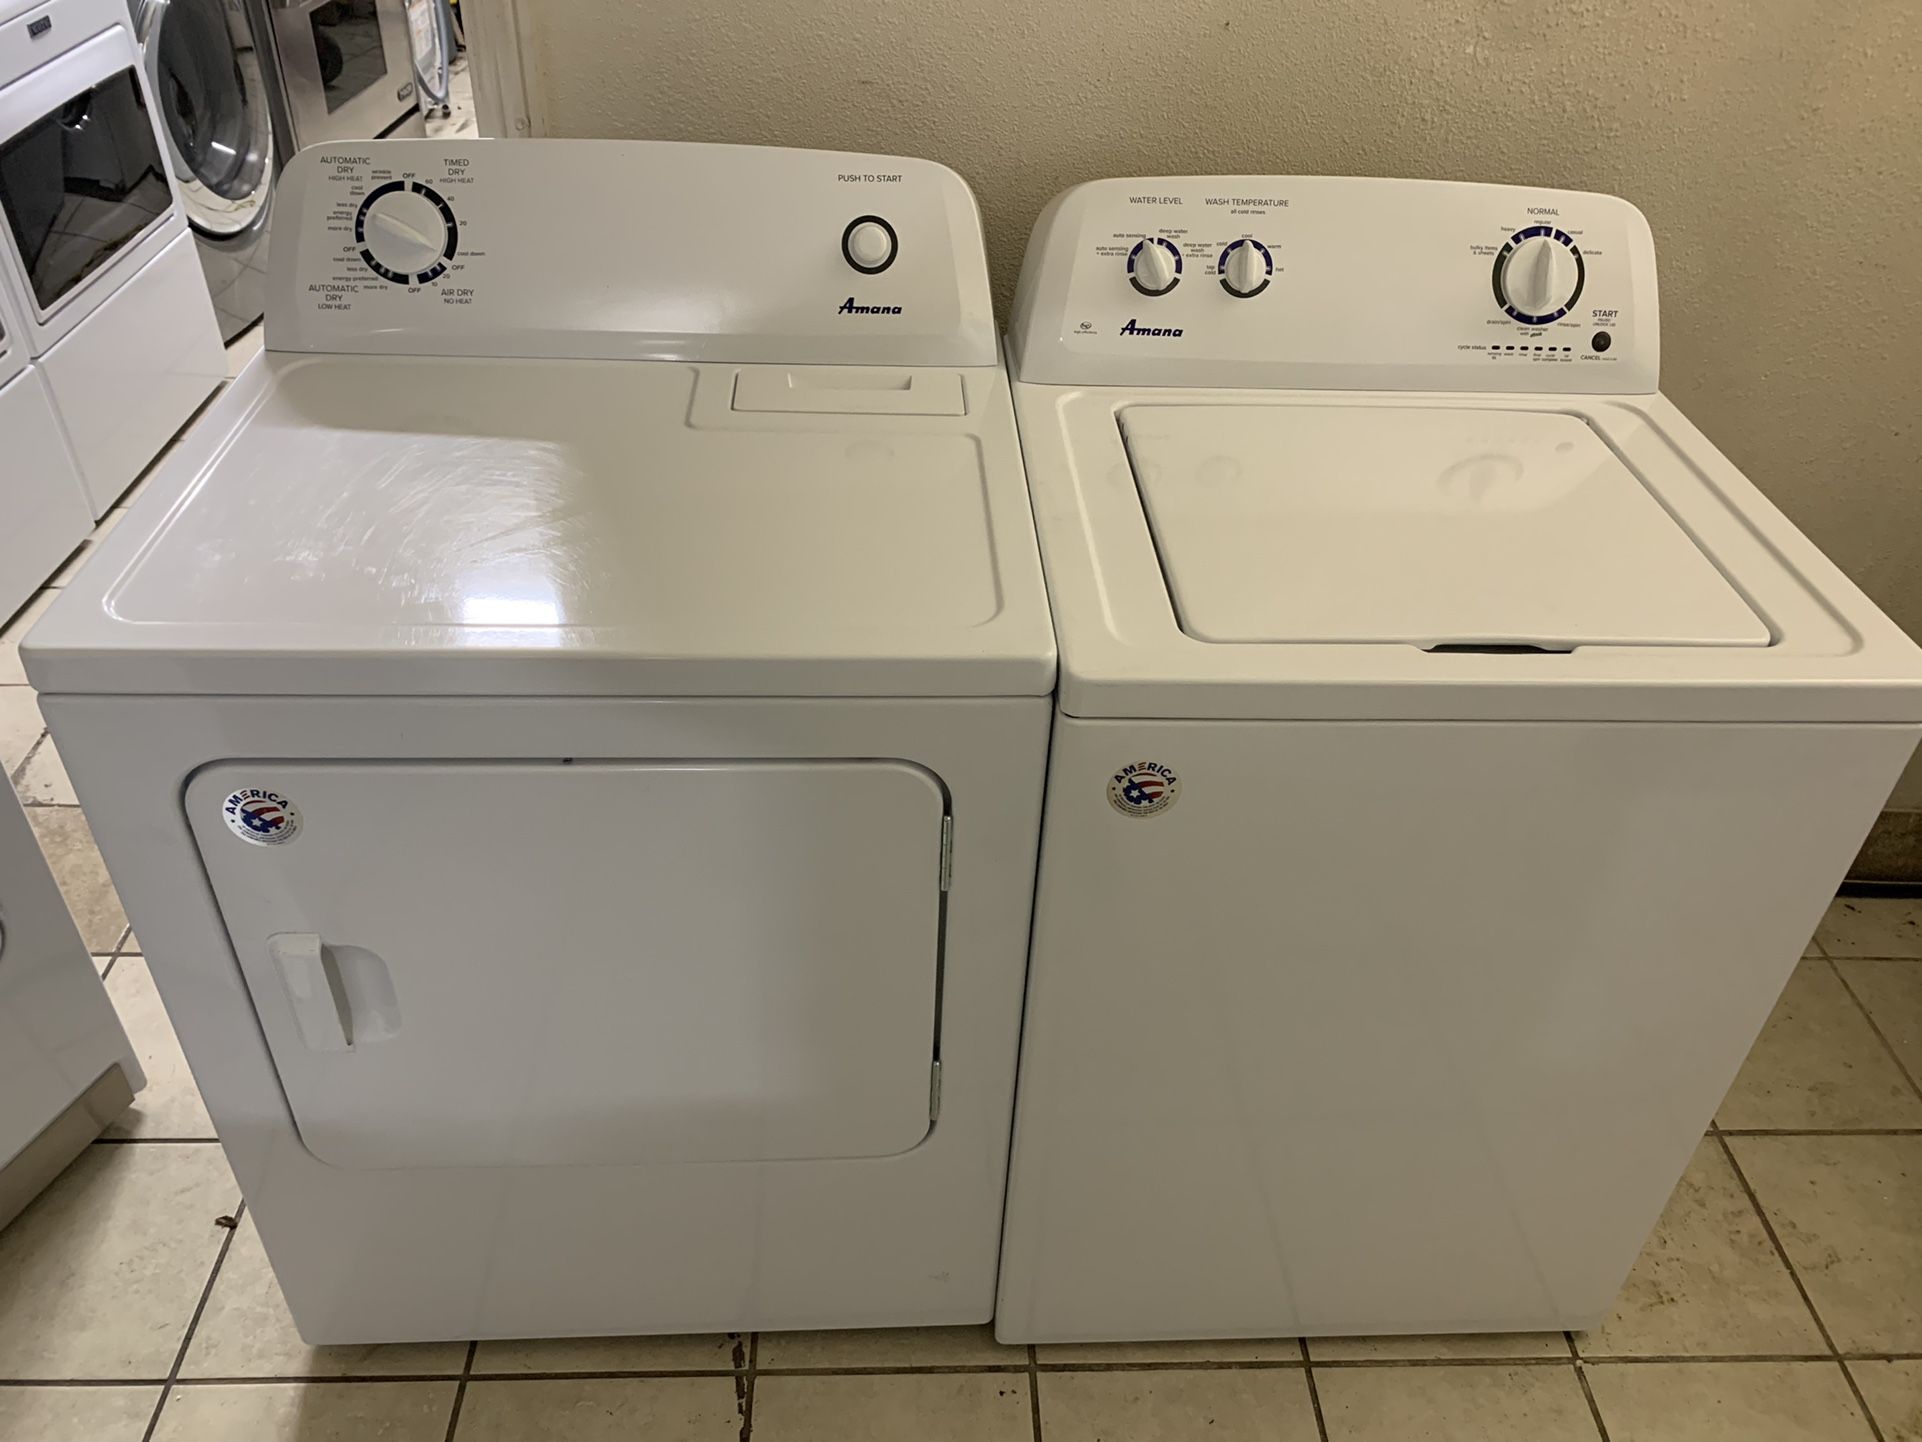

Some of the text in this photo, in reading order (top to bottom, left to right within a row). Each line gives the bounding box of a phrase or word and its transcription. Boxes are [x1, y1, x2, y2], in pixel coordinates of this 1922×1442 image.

[320, 156, 371, 165] AUTOMATIC
[444, 158, 470, 167] TIMED
[337, 166, 354, 174] DRY
[448, 168, 465, 176] DRY
[838, 174, 903, 183] PUSH TO START
[1129, 196, 1184, 205] WATER LEVEL
[1204, 197, 1289, 207] WASH TEMPERATURE
[1526, 207, 1560, 217] NORMAL
[308, 284, 359, 293] AUTOMATIC
[441, 288, 474, 297] AIR DRY
[325, 294, 343, 302] DRY
[838, 297, 902, 315] Amana
[1592, 310, 1619, 318] START
[1120, 319, 1183, 337] Amana
[1114, 761, 1177, 786] AMERICA
[225, 789, 289, 815] AMERICA
